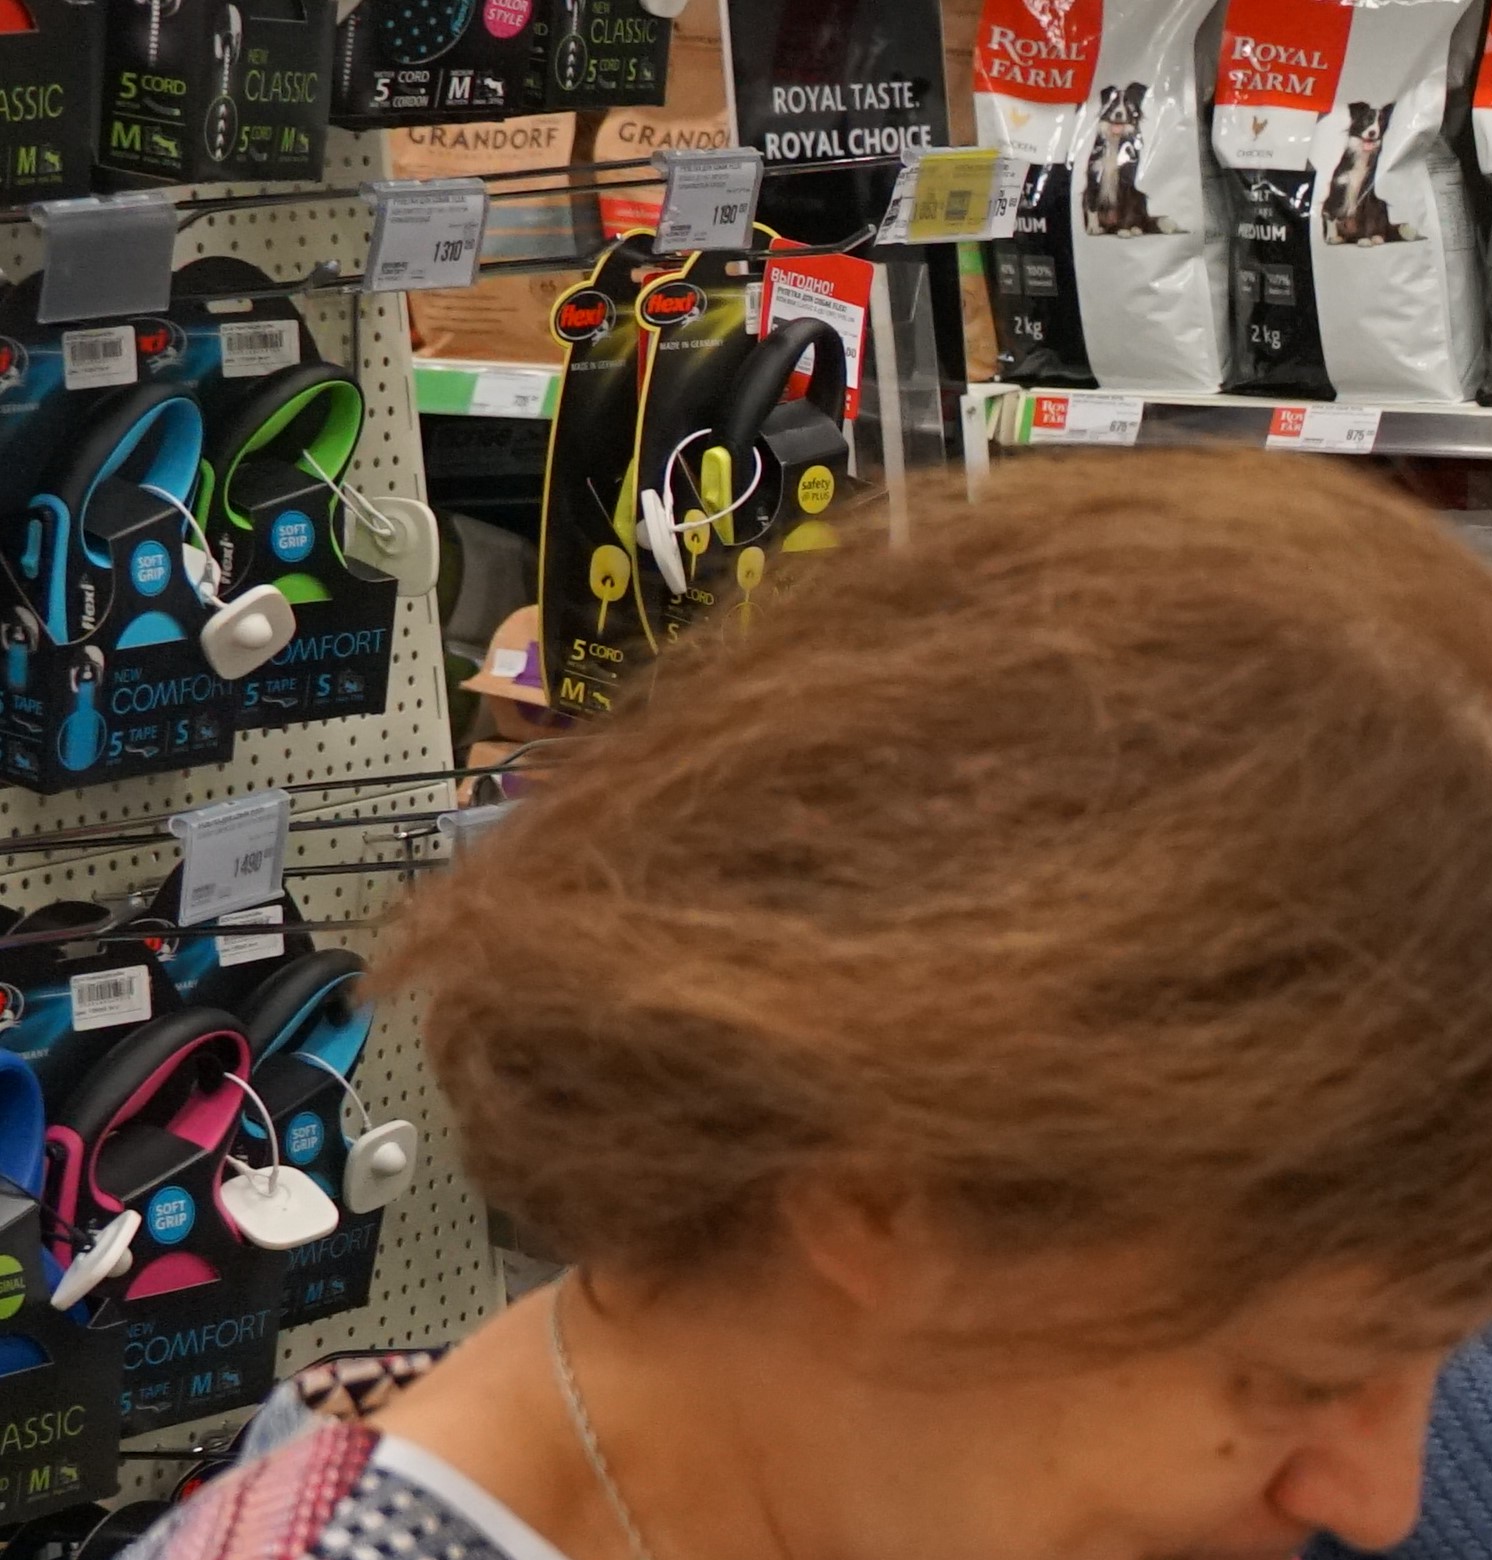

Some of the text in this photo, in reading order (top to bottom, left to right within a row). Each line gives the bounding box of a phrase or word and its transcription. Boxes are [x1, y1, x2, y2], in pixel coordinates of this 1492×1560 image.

[487, 8, 524, 27] STYLE
[590, 19, 656, 44] CLASSIC
[987, 24, 1086, 67] ROYAL
[1232, 36, 1328, 73] ROYAL
[587, 59, 597, 82] 5
[989, 58, 1075, 89] FARM
[119, 72, 186, 98] 5 CORD
[245, 70, 318, 103] CLASSIC
[374, 71, 471, 102] 5 CORD M
[1231, 70, 1317, 97] FARM
[772, 81, 920, 114] ROYAL TASTE.
[110, 121, 141, 151] M
[239, 126, 250, 152] 5
[408, 125, 559, 151] GRANDORF
[764, 125, 932, 160] ROYAL CHOICE
[17, 146, 36, 175] M
[771, 267, 835, 295] ВЫГОДНО!
[1014, 317, 1043, 340] 2 kg
[1251, 325, 1281, 349] 2 kg
[801, 477, 831, 492] safety
[278, 523, 307, 536] SOFT
[278, 535, 308, 550] GRIP
[137, 554, 164, 567] SOFT
[137, 566, 165, 581] GRIP
[271, 628, 387, 666] OMFORT
[571, 639, 624, 663] 5 CORD
[114, 668, 143, 683] NEW
[244, 674, 331, 707] 5 TAPE S
[560, 677, 586, 703] M
[14, 697, 43, 714] TAPE
[109, 720, 189, 757] 5 TAPE S
[292, 1124, 318, 1140] SOFT
[292, 1136, 318, 1152] GRIP
[155, 1200, 186, 1217] SOFT
[155, 1213, 188, 1231] GRIP
[123, 1310, 271, 1370] COMFORT
[128, 1322, 154, 1339] NEW
[138, 1383, 171, 1398] TAPE
[191, 1376, 212, 1397] M
[29, 1470, 50, 1492] M
